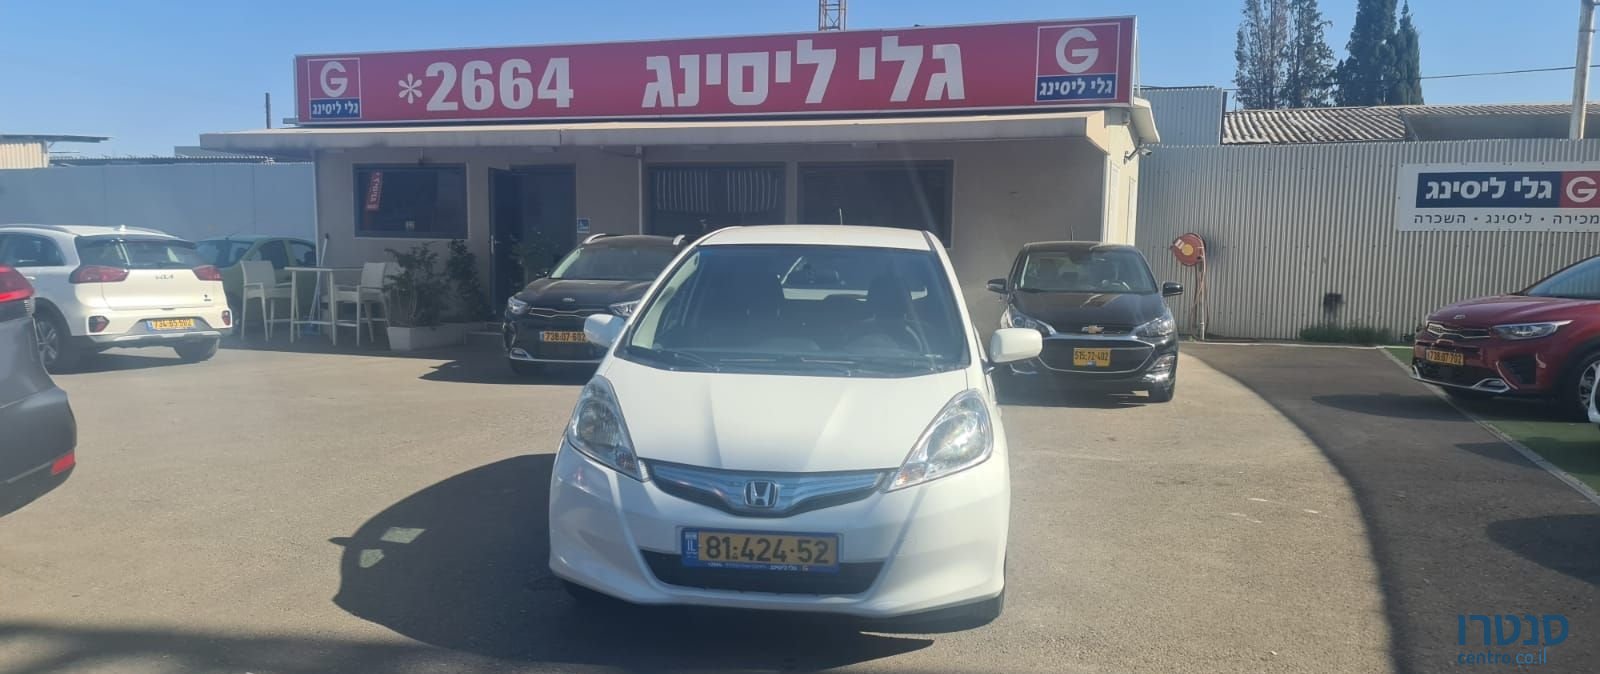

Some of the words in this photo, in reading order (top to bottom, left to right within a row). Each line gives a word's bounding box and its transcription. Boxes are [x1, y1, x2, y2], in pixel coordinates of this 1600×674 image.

[1056, 28, 1099, 73] G
[320, 61, 348, 97] G
[641, 39, 837, 108] ליסינג
[859, 35, 965, 102] גלי
[1039, 77, 1086, 96] ליסינג
[1091, 77, 1113, 95] גלי
[312, 100, 341, 115] ליסינג
[344, 100, 358, 114] גלי
[1425, 176, 1507, 200] ליסינג
[1514, 176, 1553, 199] גלי
[1566, 176, 1598, 203] G
[1414, 213, 1467, 224] השכרה
[1485, 212, 1533, 224] ליסינג
[1552, 213, 1600, 225] מכירה
